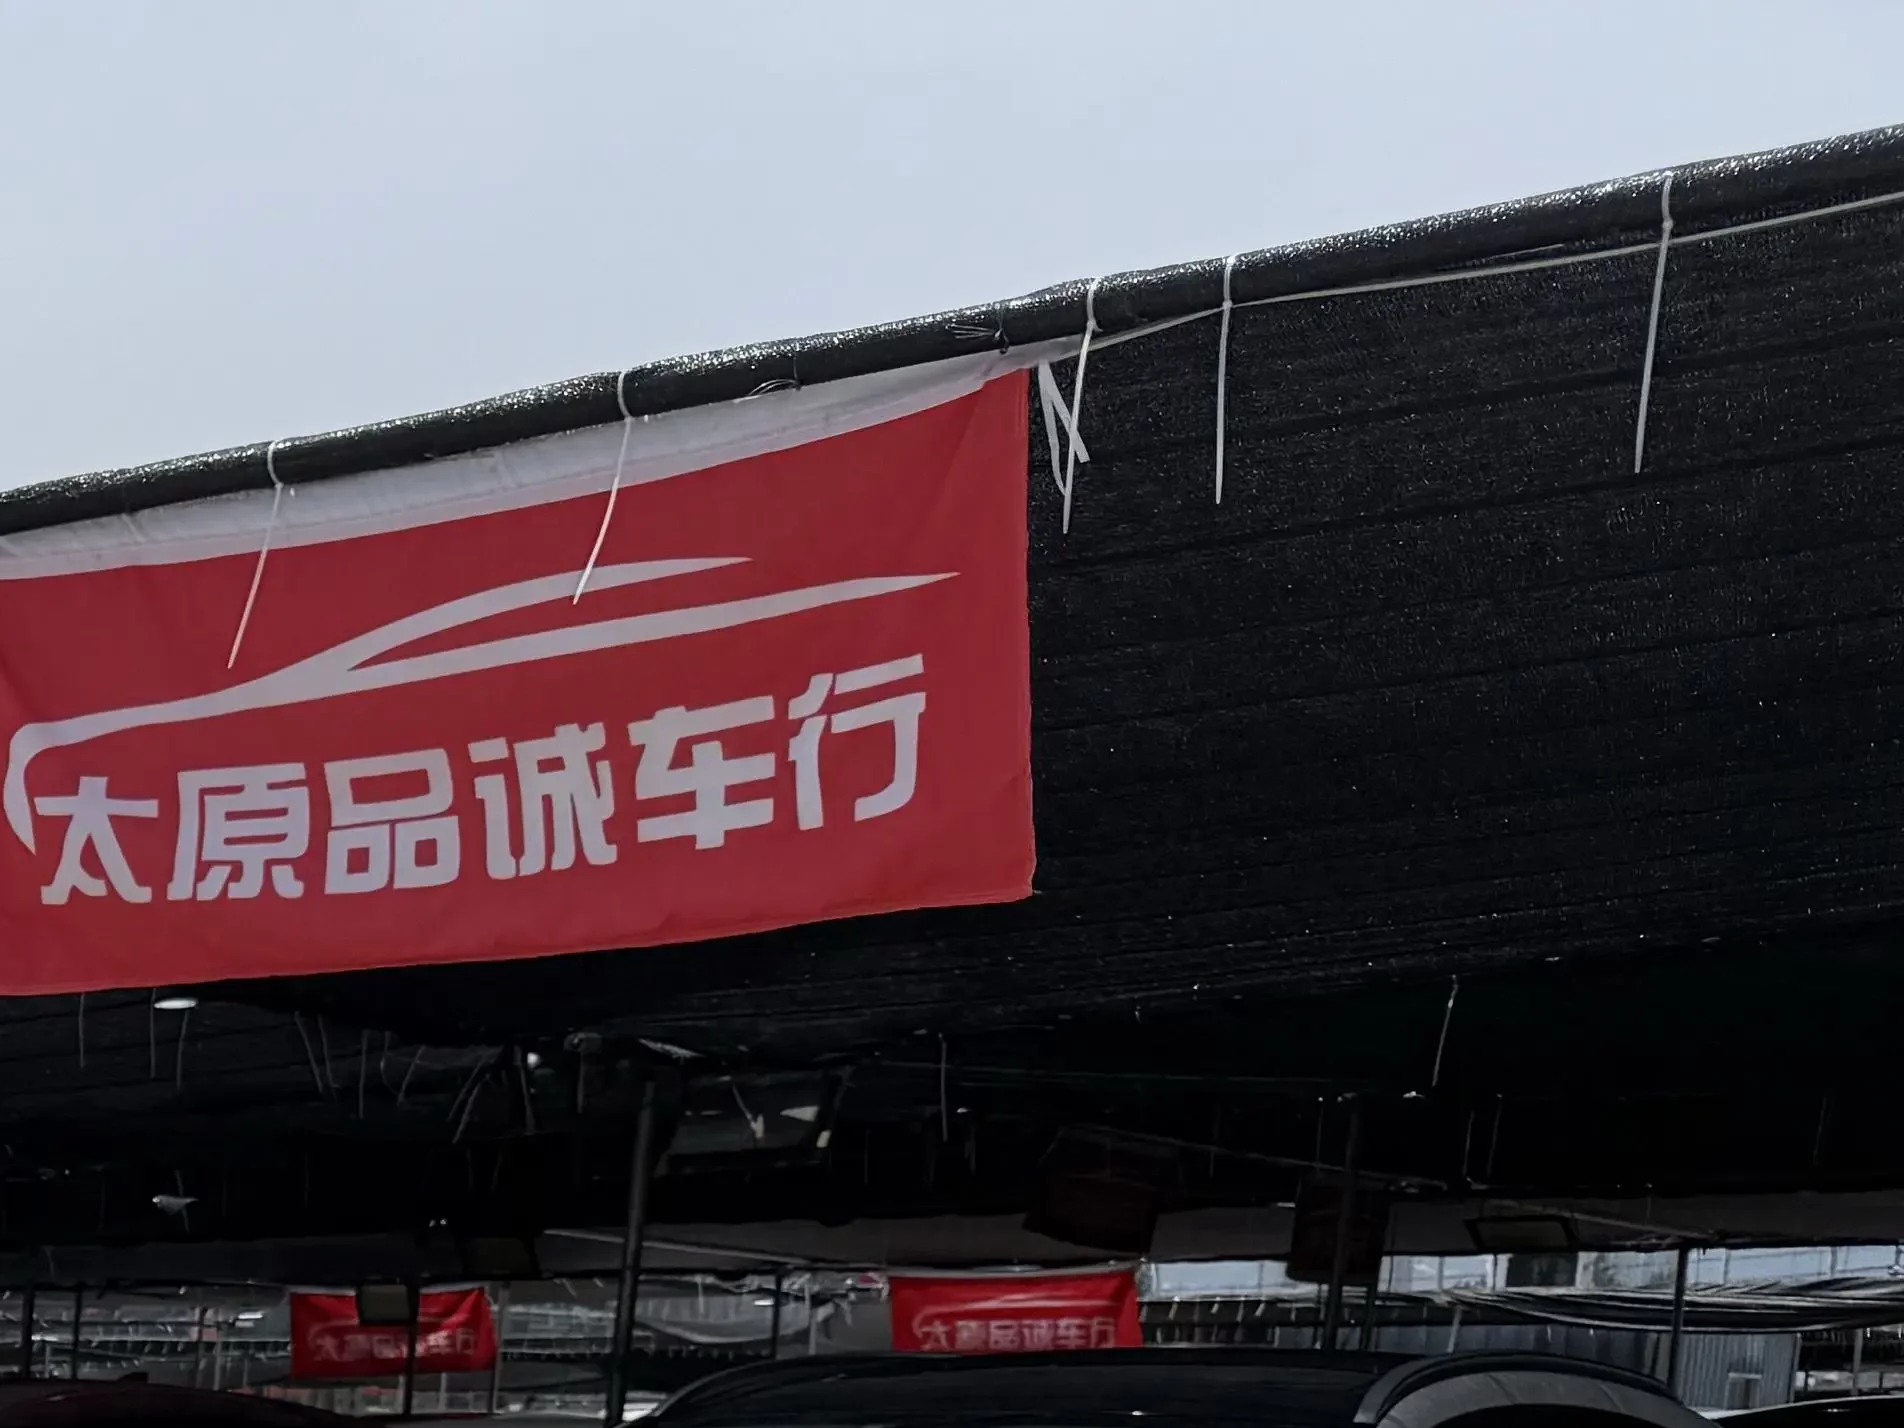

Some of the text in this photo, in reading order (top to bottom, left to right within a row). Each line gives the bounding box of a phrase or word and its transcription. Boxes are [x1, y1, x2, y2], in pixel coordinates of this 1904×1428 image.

[34, 652, 927, 906] 太原品诚车行
